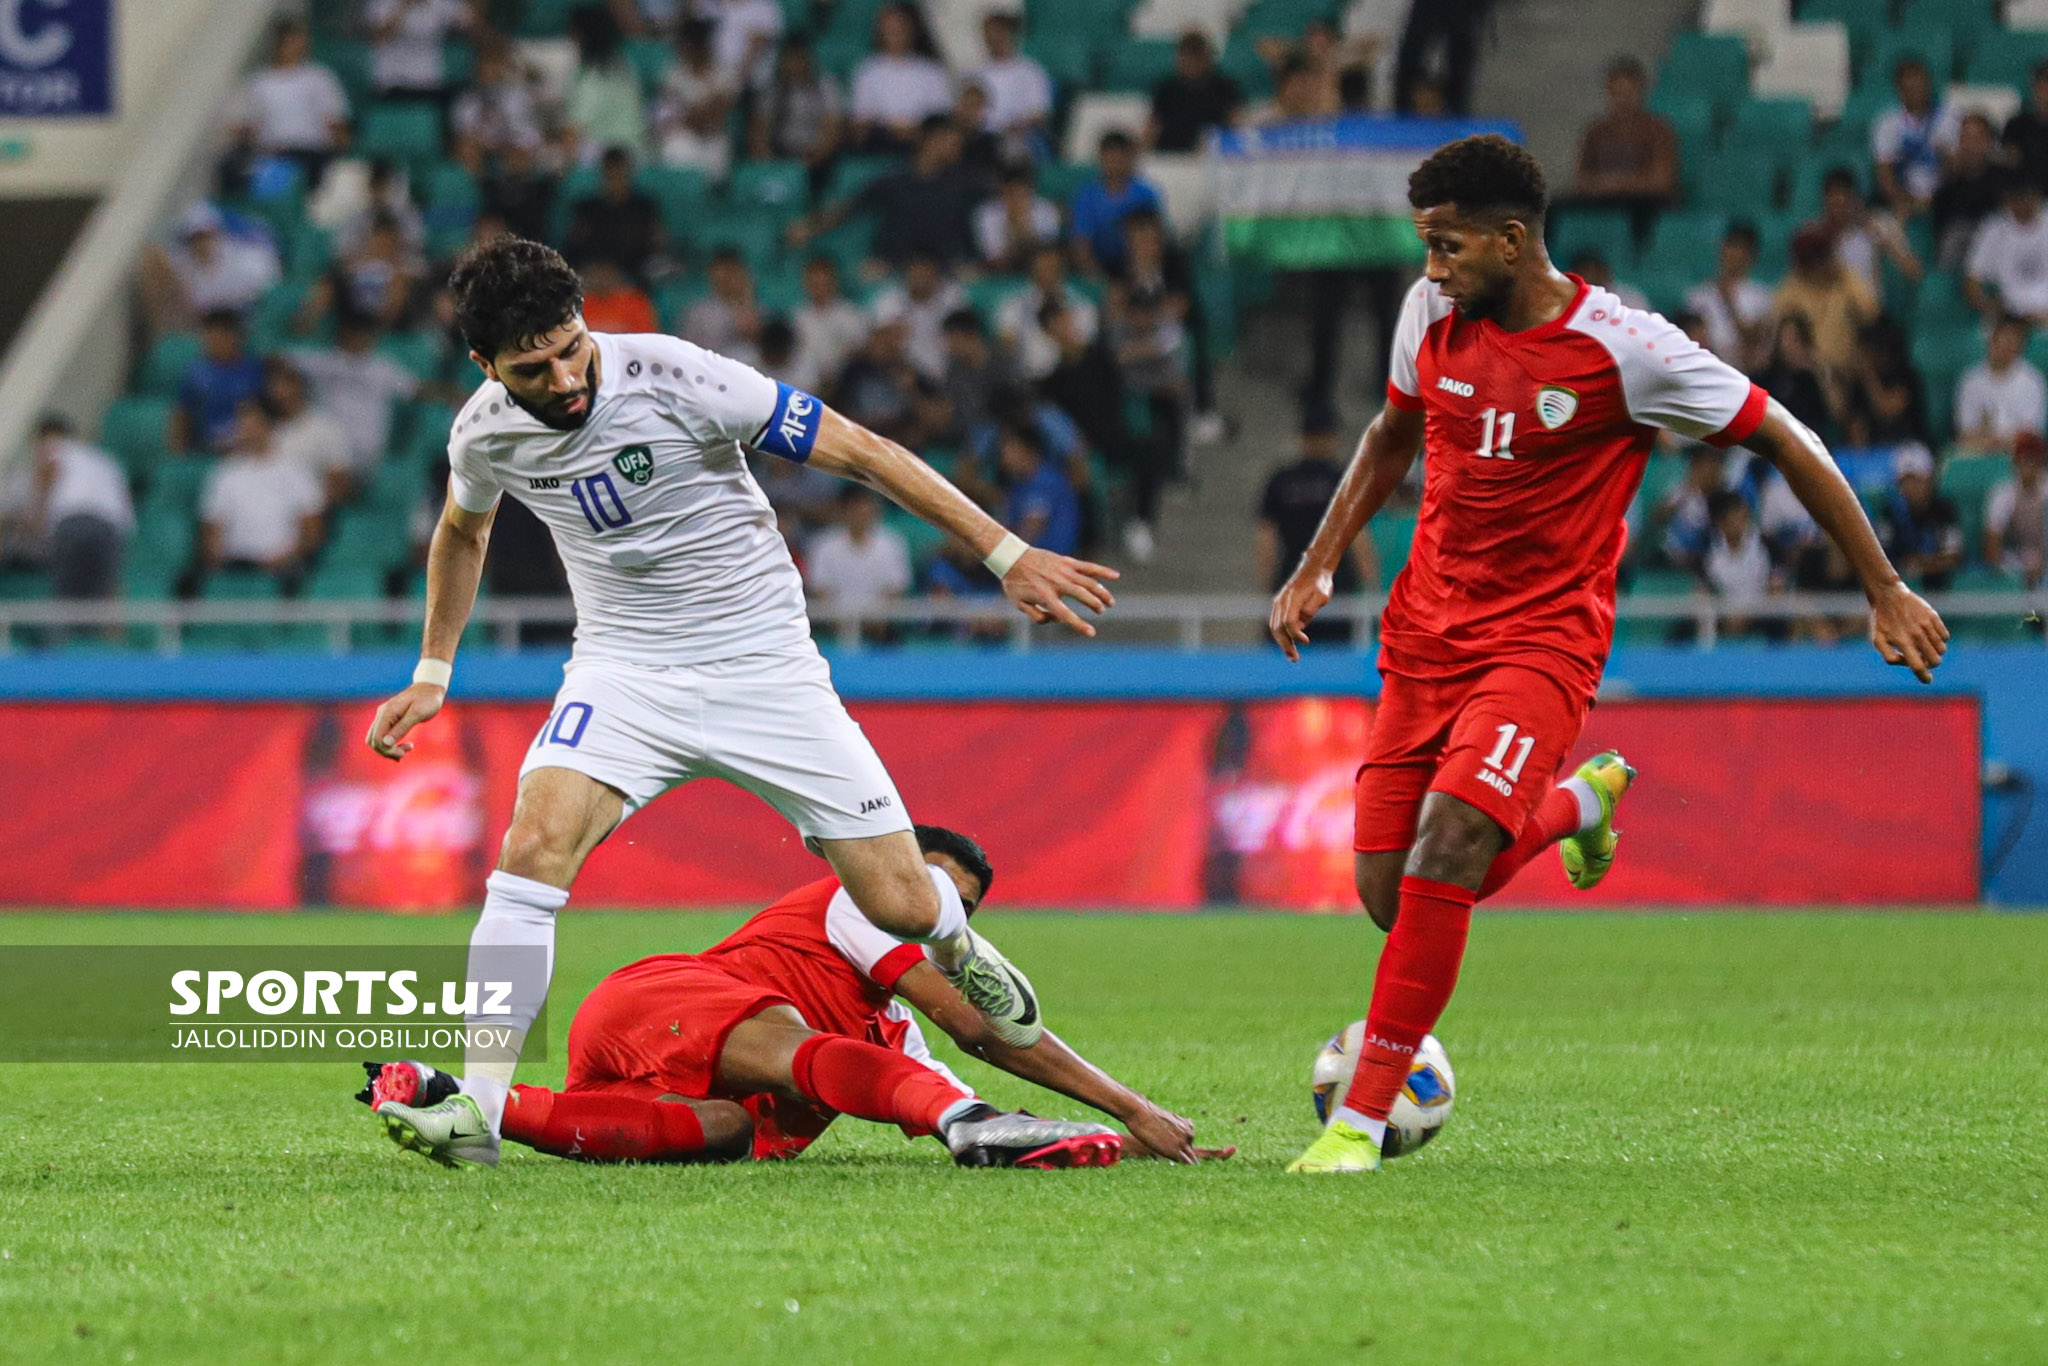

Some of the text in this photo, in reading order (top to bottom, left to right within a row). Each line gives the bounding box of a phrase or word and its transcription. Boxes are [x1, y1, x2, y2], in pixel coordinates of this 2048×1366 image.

[1438, 376, 1476, 398] JAKO
[779, 390, 814, 453] AFC
[1476, 407, 1516, 460] 11
[618, 451, 650, 473] UFA
[529, 477, 560, 490] JAKO
[571, 472, 632, 534] 10
[1481, 722, 1537, 784] 11
[1474, 767, 1513, 797] JAKO
[860, 795, 891, 814] JAKO
